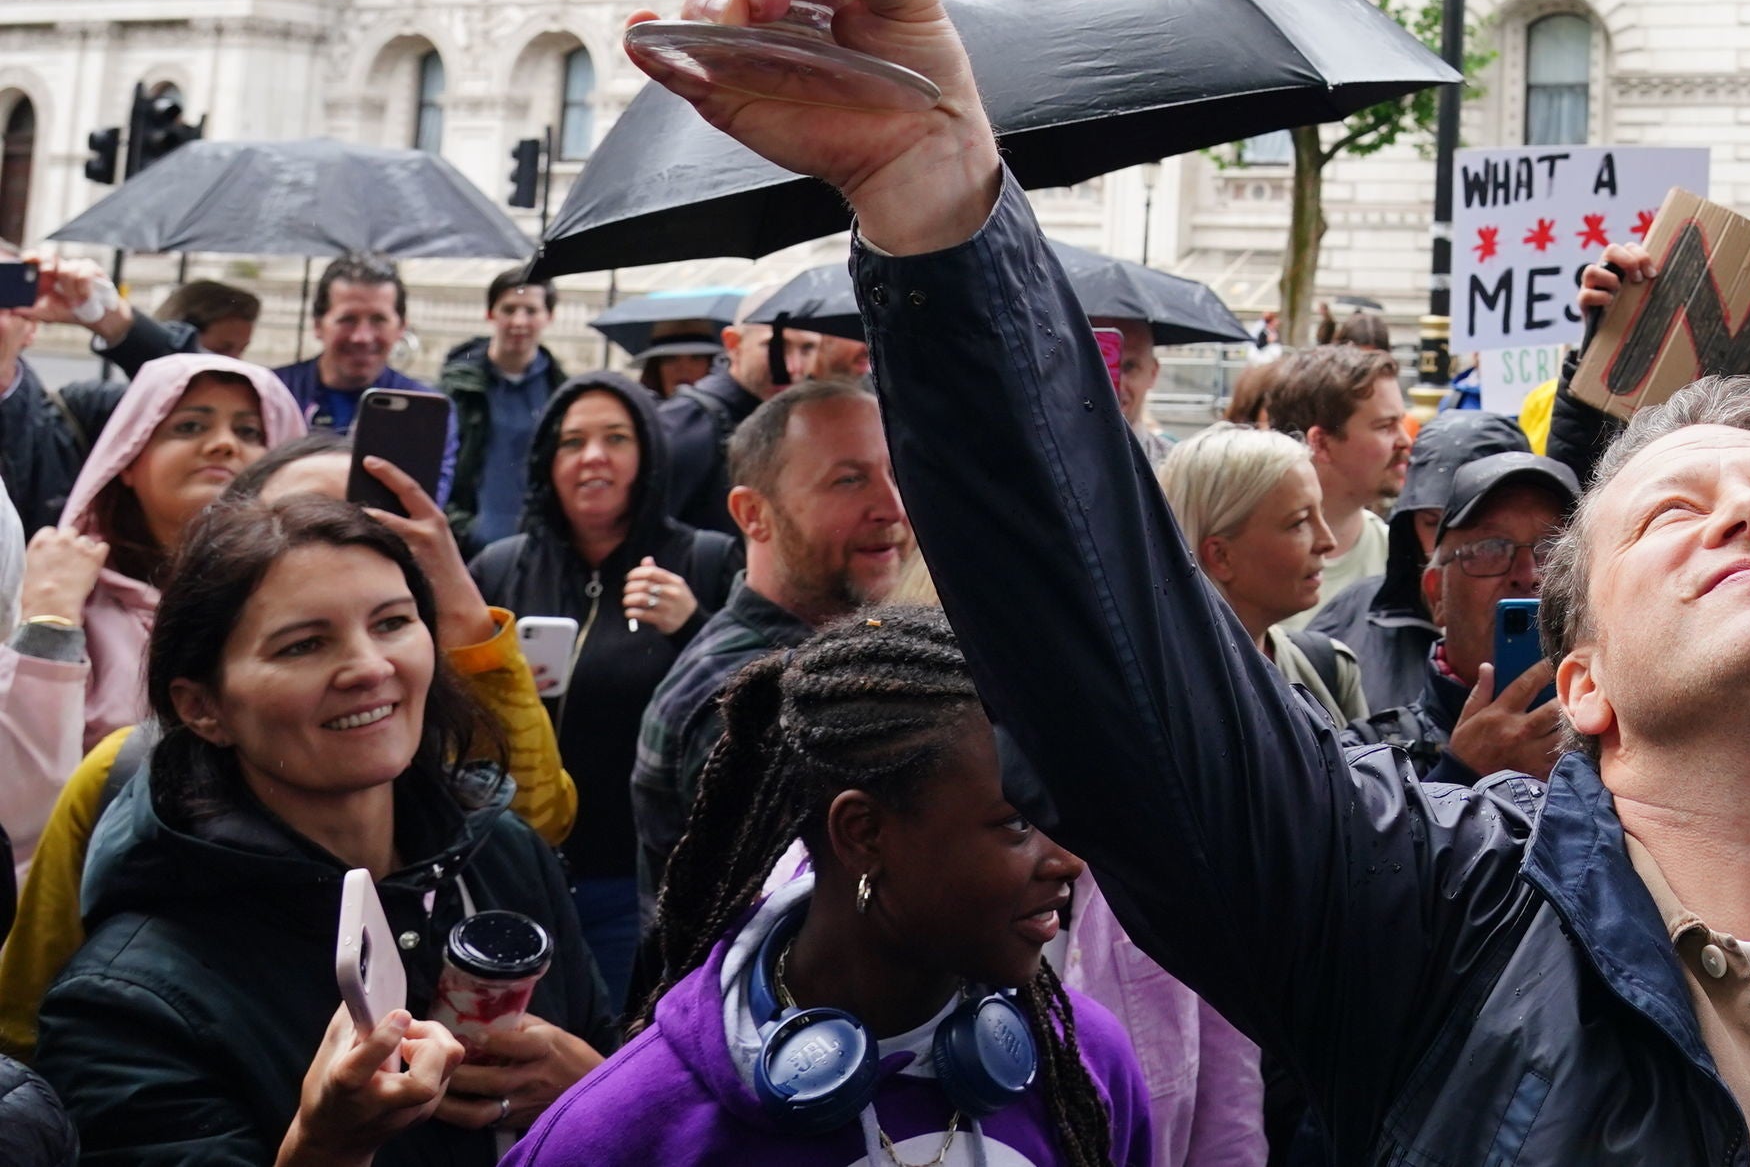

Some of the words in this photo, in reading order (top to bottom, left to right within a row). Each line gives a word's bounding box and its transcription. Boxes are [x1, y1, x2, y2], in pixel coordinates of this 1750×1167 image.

[1462, 153, 1570, 209] WHAT
[1593, 152, 1617, 196] A
[788, 1035, 839, 1074] JBL
